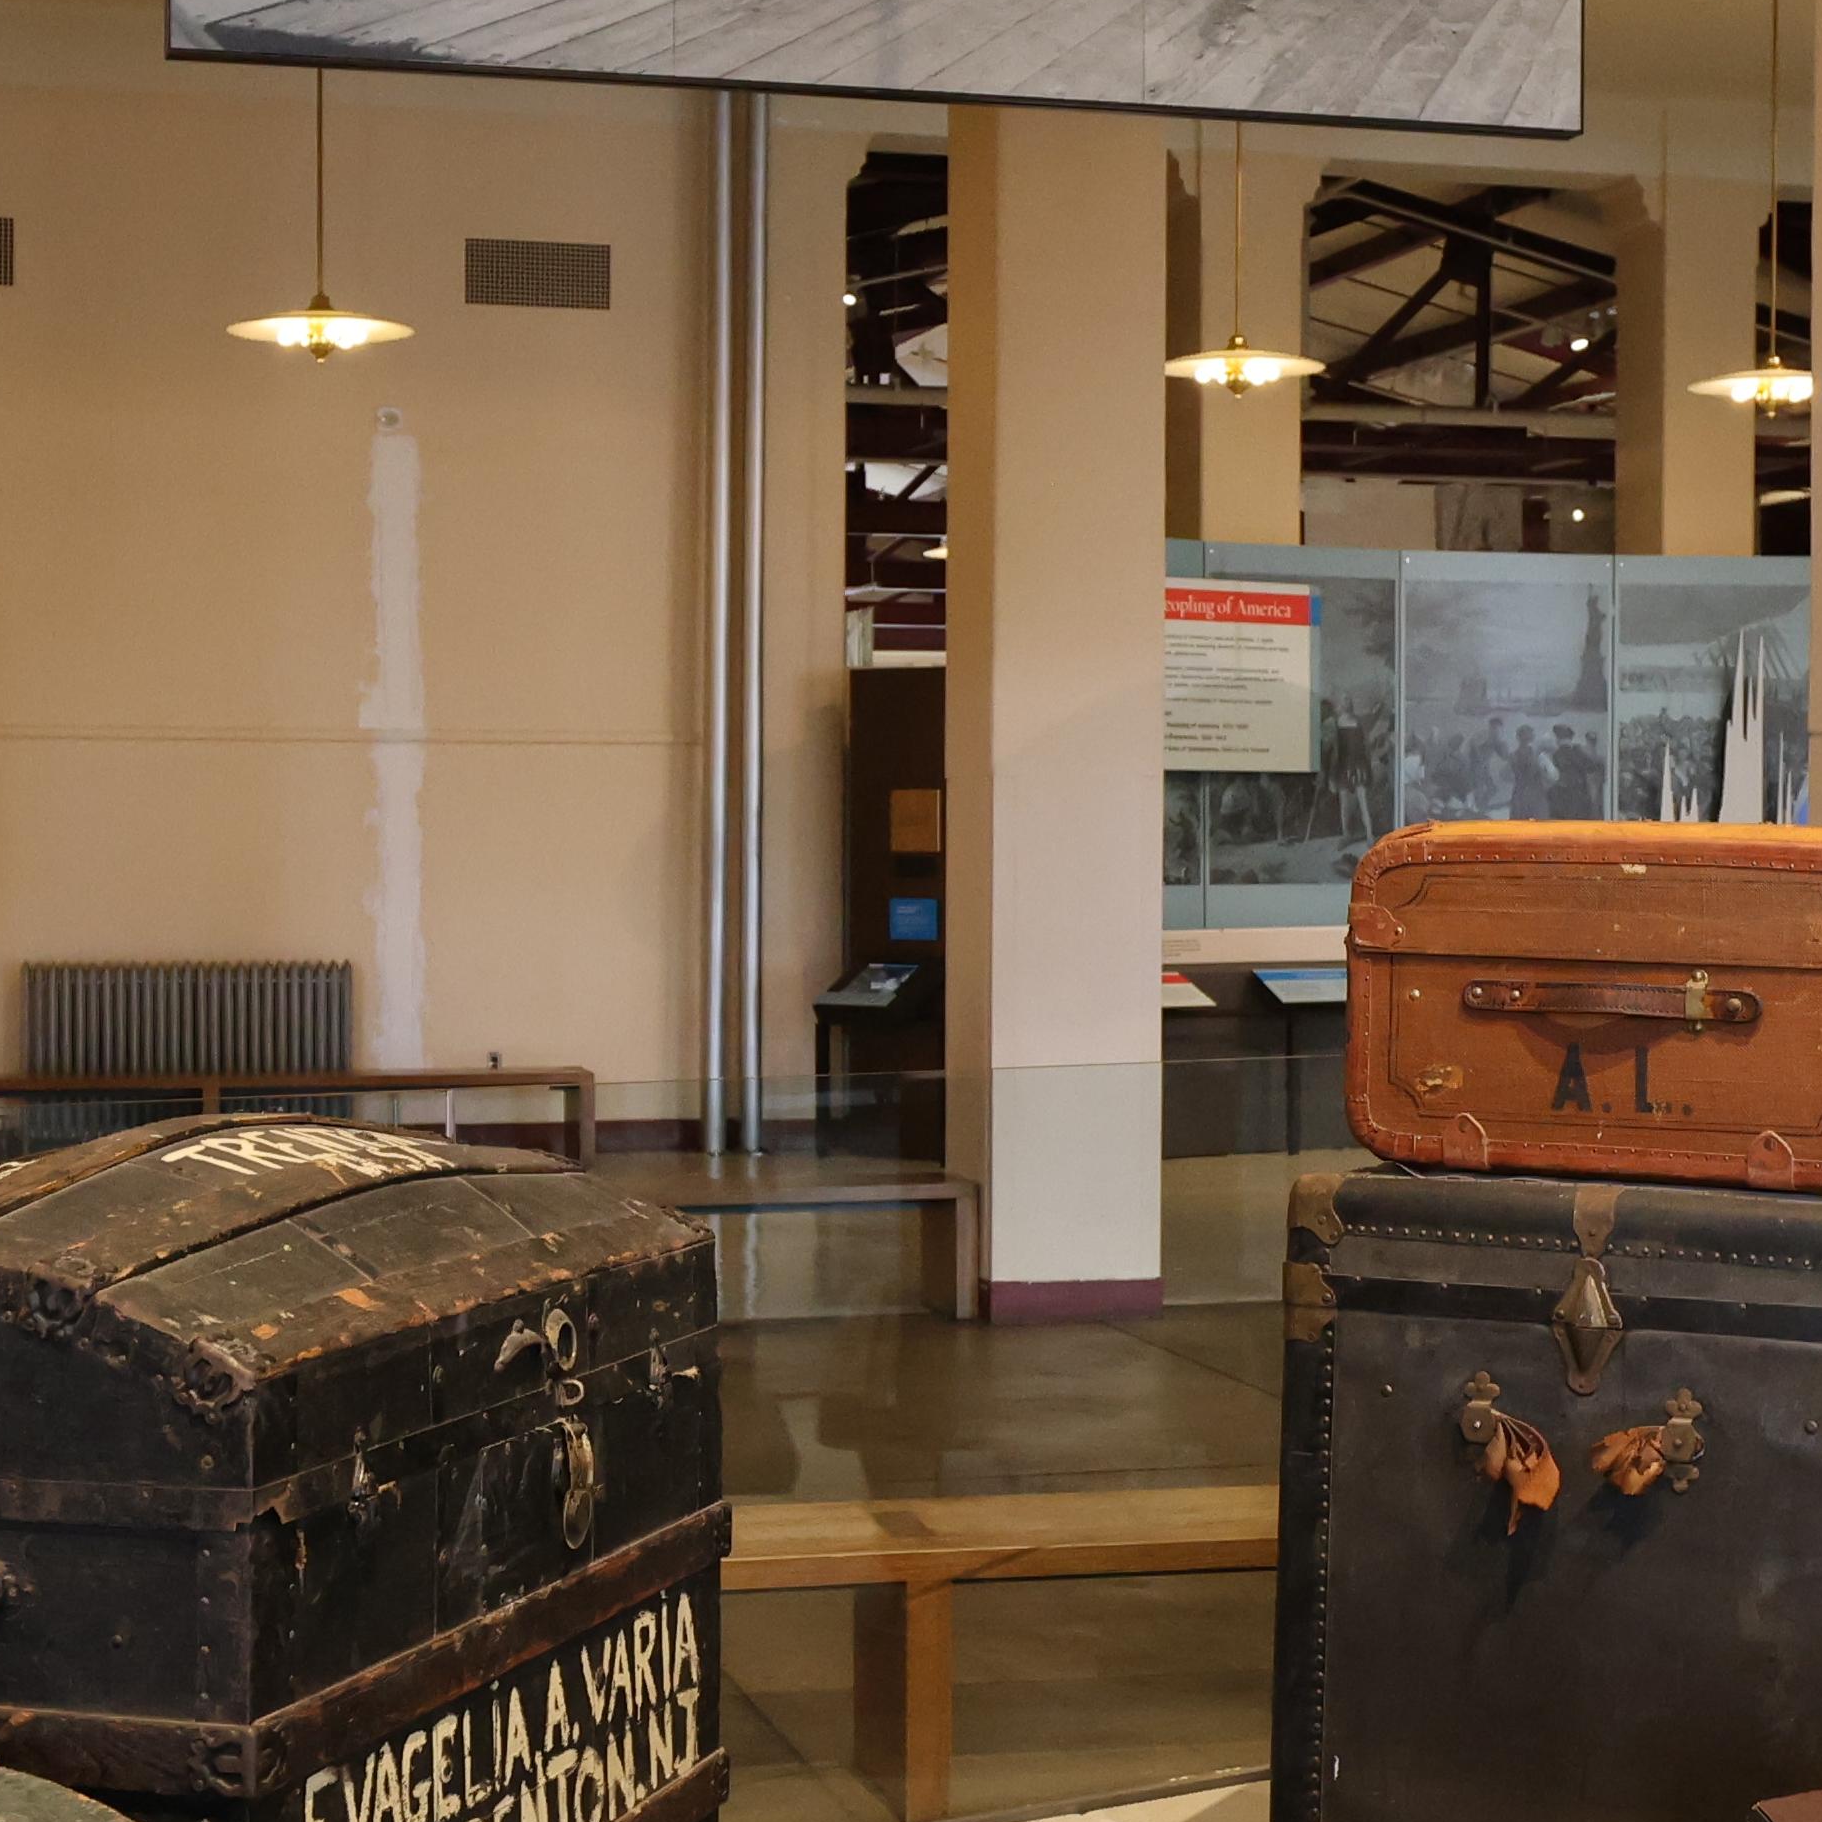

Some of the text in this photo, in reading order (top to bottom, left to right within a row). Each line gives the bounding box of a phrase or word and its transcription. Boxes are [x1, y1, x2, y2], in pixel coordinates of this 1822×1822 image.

[1165, 594, 1292, 620] eopling of America
[580, 1590, 700, 1725] VARIA
